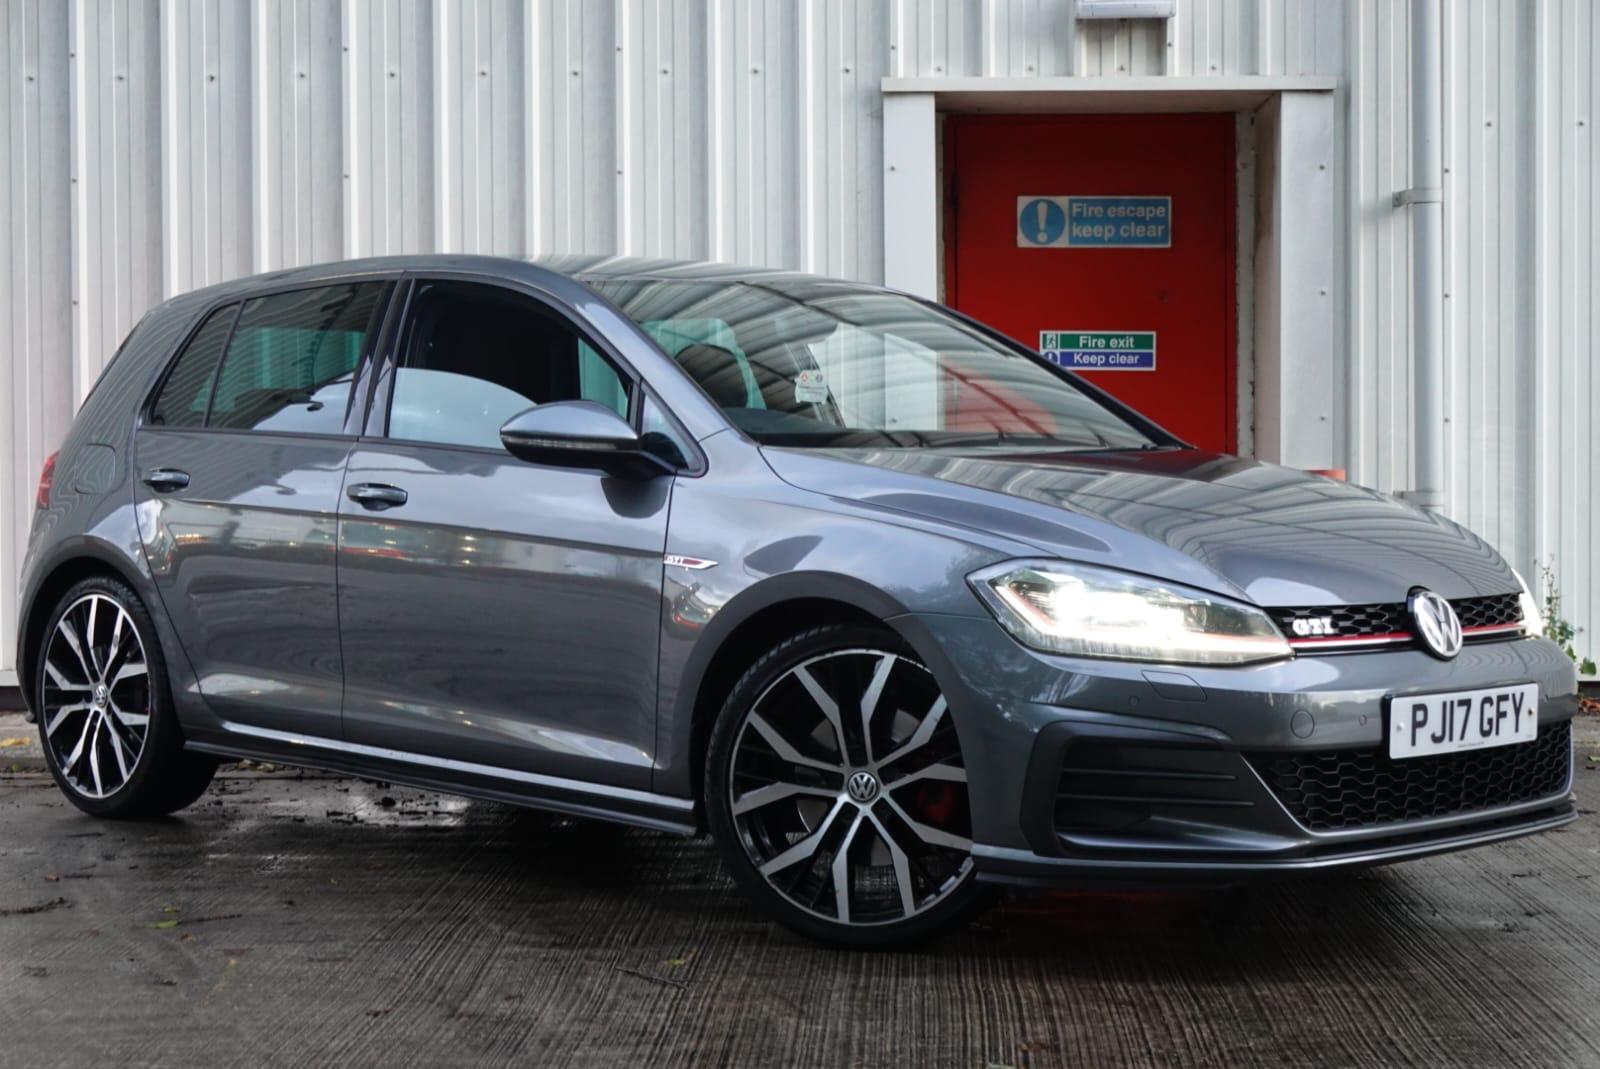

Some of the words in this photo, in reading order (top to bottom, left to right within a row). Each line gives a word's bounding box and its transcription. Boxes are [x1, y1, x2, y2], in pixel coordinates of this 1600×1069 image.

[1072, 203, 1103, 217] Fire
[1107, 206, 1165, 220] escape
[1072, 222, 1116, 241] keep
[1120, 222, 1165, 238] clear
[1079, 335, 1105, 348] Fire
[1109, 335, 1135, 348] exit
[1073, 353, 1105, 366] Keep
[1108, 353, 1139, 364] clear
[1292, 617, 1333, 635] GTI
[1411, 698, 1472, 746] PJ17
[1479, 692, 1524, 738] GFY
